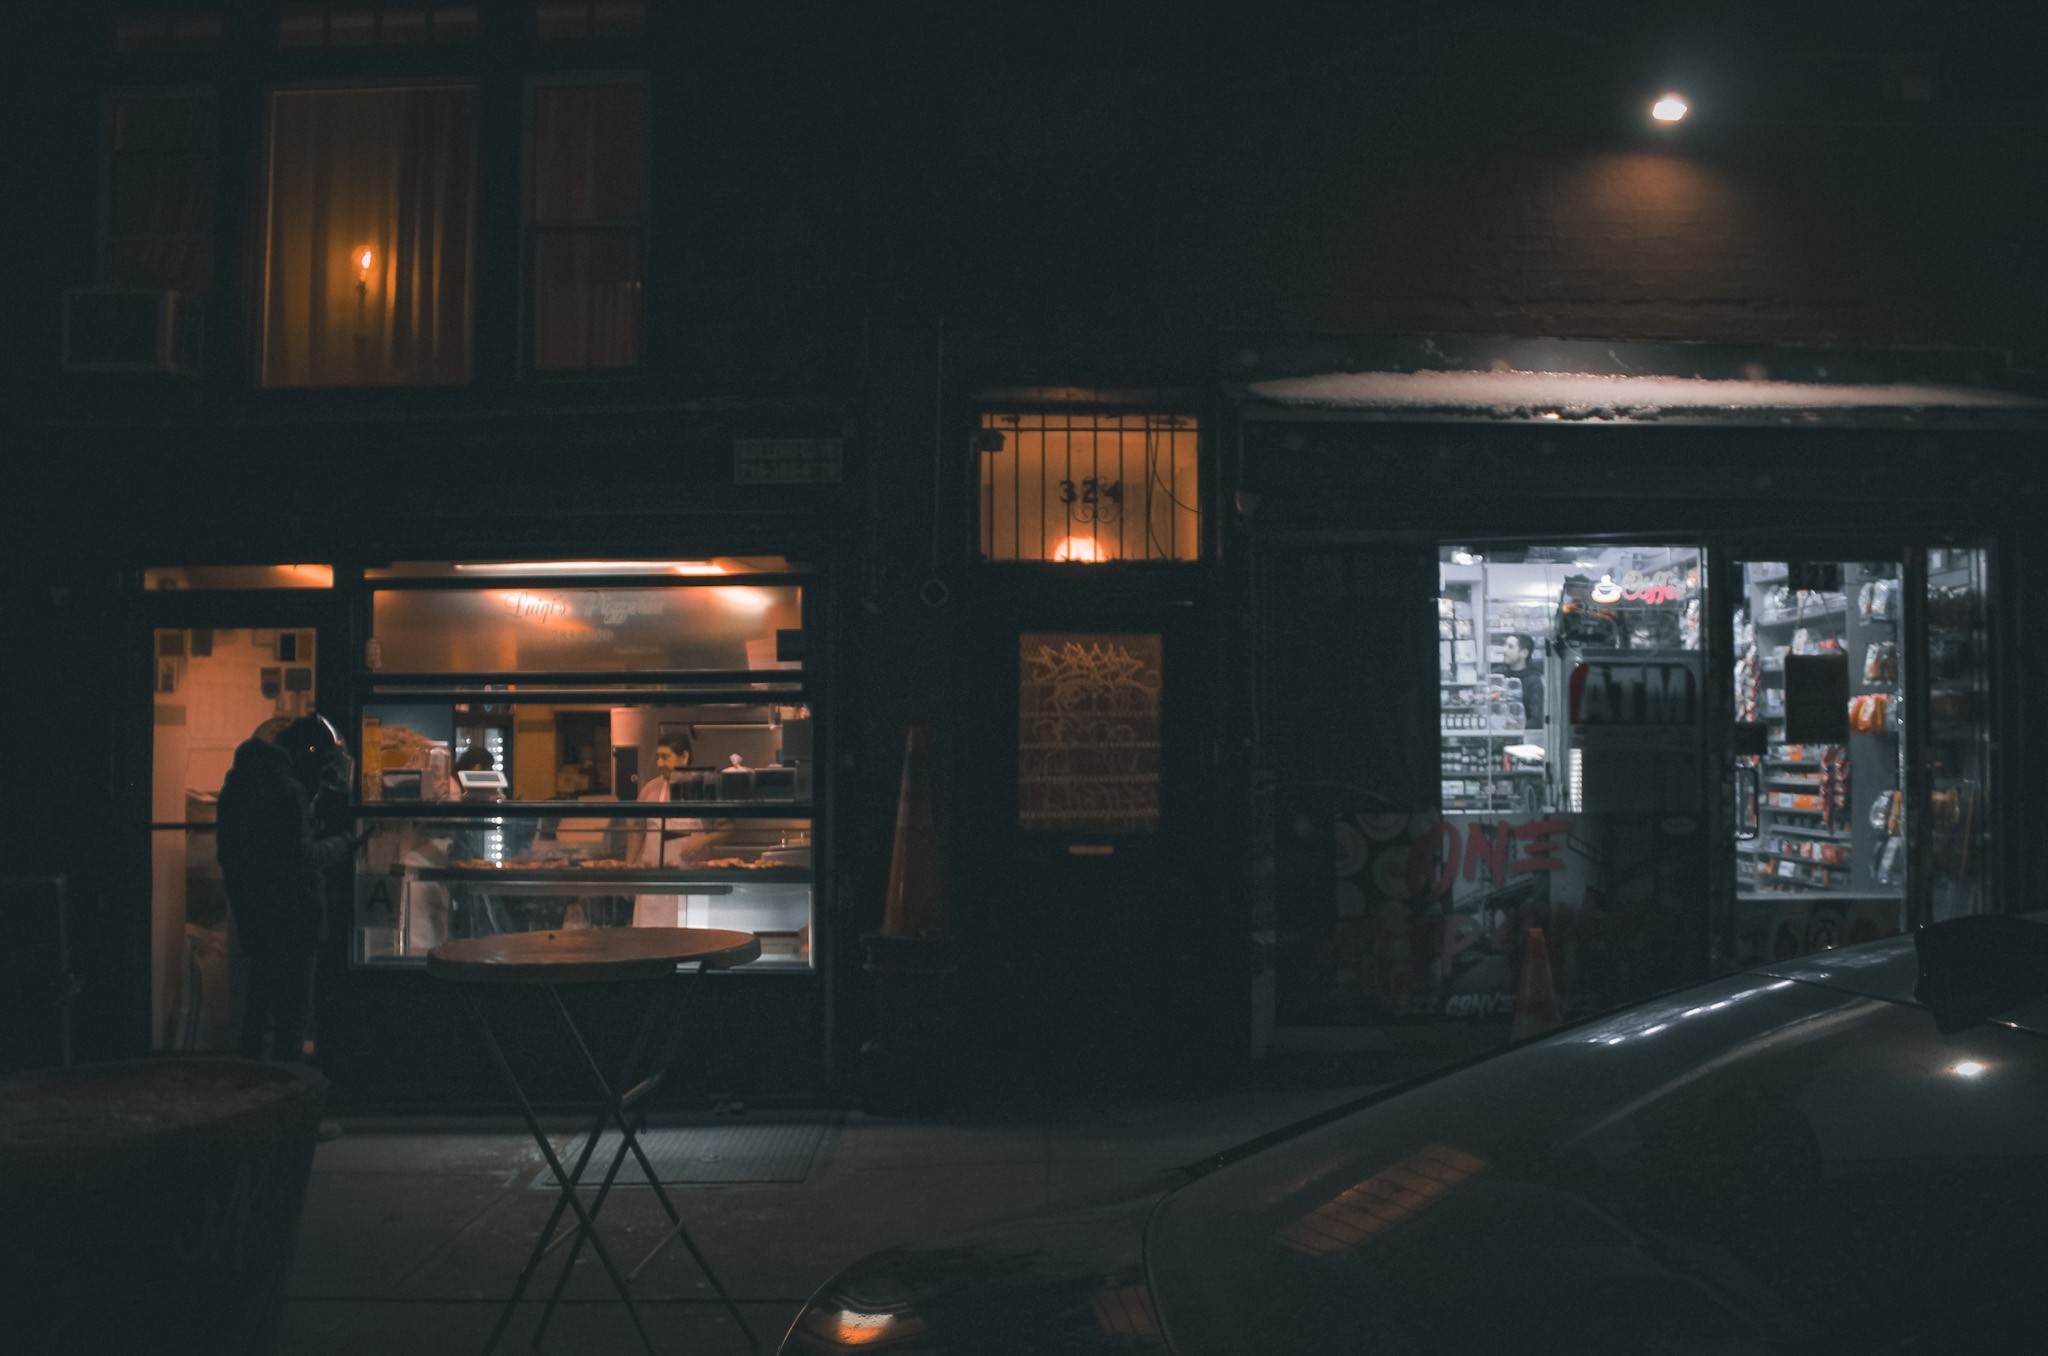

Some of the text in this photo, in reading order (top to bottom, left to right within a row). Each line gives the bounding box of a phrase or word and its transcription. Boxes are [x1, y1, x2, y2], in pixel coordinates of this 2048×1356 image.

[1060, 479, 1121, 504] 324
[505, 591, 567, 624] Luigi's
[1579, 664, 1688, 724] ATM
[1407, 818, 1570, 896] ONE
[365, 879, 394, 912] A
